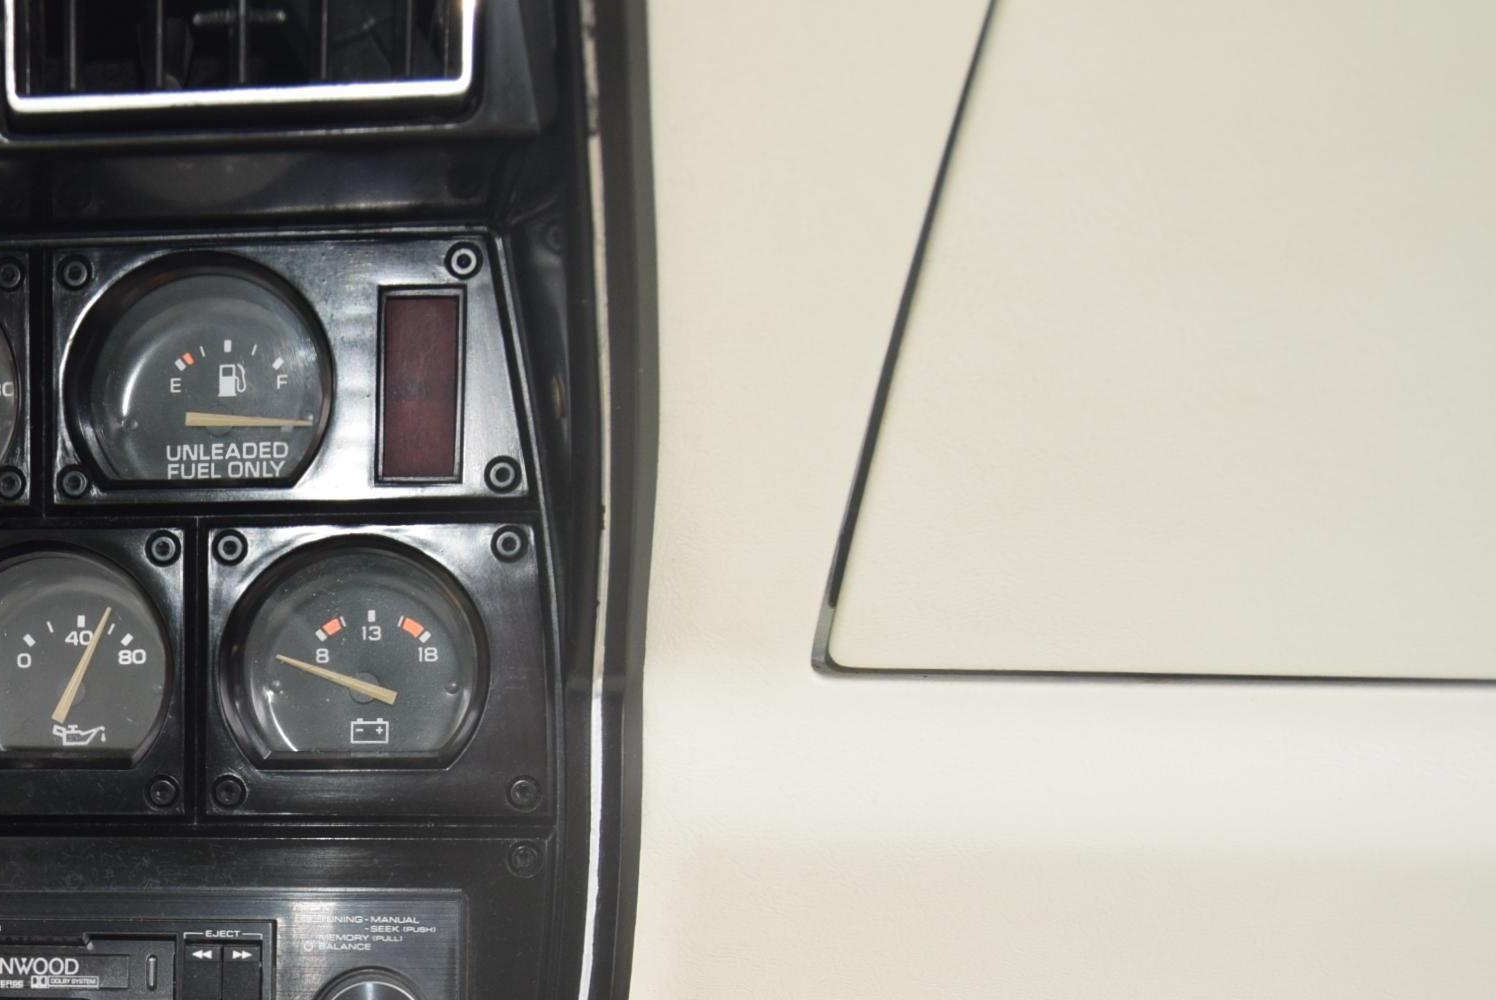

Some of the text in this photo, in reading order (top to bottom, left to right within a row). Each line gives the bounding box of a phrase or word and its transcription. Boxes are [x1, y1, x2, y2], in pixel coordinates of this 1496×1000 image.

[170, 378, 181, 393] E
[276, 375, 288, 390] F
[166, 442, 289, 461] UNLEADED
[167, 461, 285, 480] FUEL ONLY
[65, 631, 94, 646] 40
[362, 626, 381, 641] 13
[17, 652, 32, 668] 0
[118, 649, 146, 665] 80
[316, 648, 329, 663] 8
[418, 647, 438, 662] 18
[205, 930, 241, 938] EJECT
[318, 934, 369, 942] MEMORY
